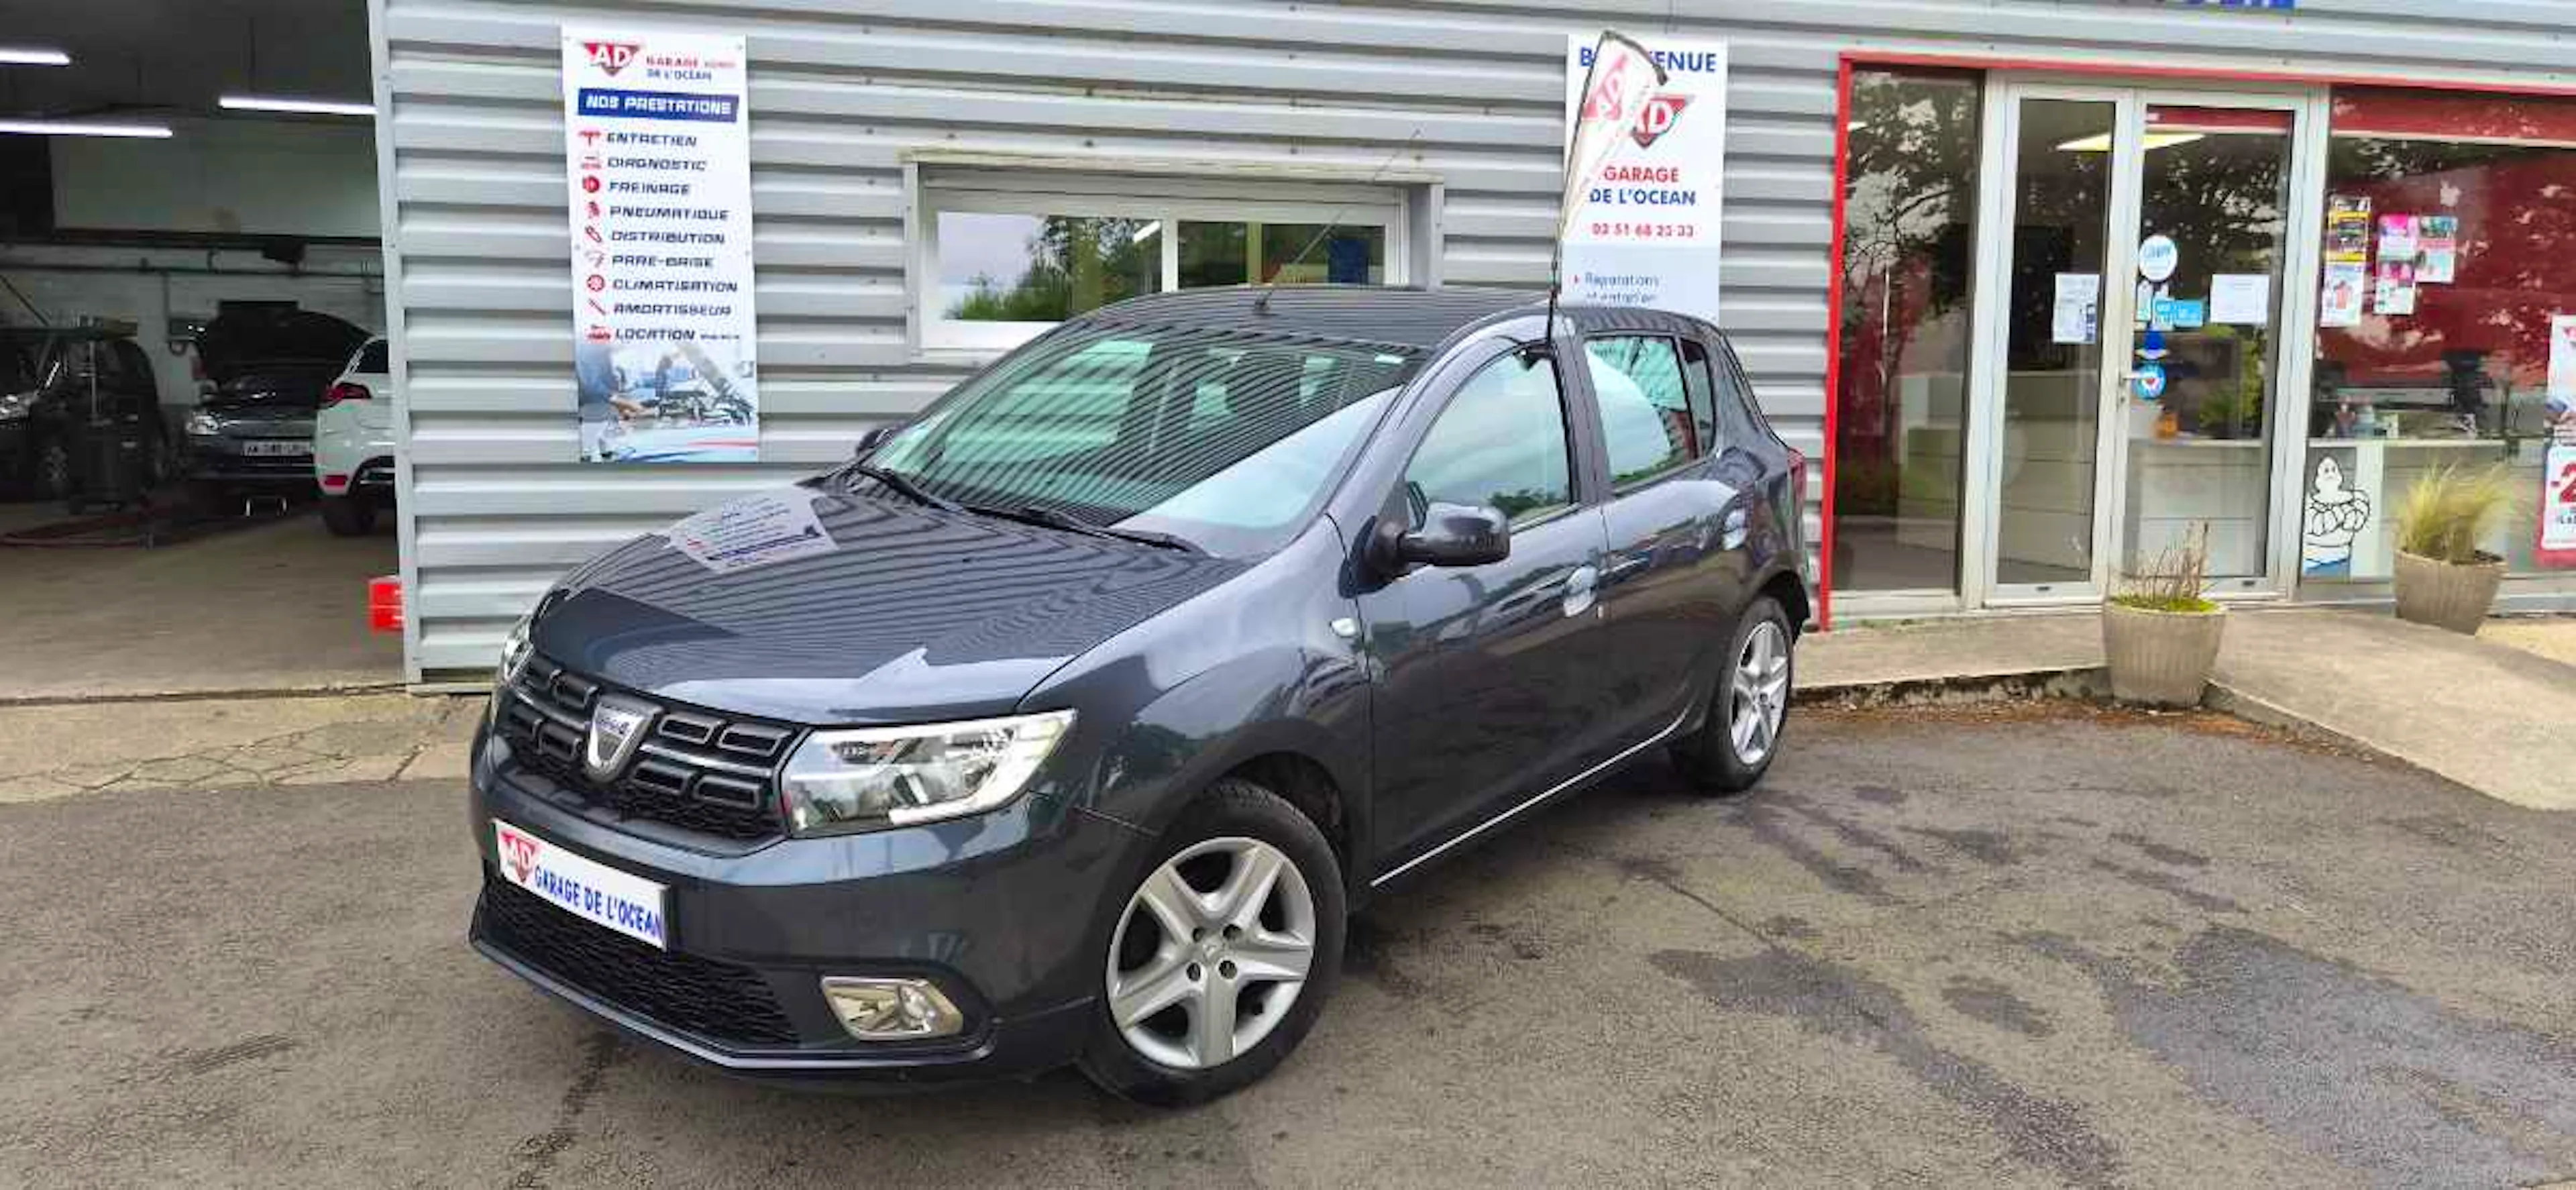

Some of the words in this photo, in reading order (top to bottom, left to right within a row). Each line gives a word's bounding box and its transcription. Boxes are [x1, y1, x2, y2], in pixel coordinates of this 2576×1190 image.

[589, 44, 633, 68] AD
[647, 56, 698, 68] GARAGE
[1580, 47, 1717, 73] BENUE
[586, 95, 620, 109] NOS
[625, 96, 732, 115] PRESTATIONS
[607, 132, 698, 147] ENTRETIEN
[607, 157, 706, 171] DIAGNOSTIC
[1604, 167, 1680, 183] GARAGE
[608, 181, 691, 195] FREINAGE
[1590, 188, 1611, 205] DE
[1619, 189, 1696, 205] L'OCEAN
[610, 206, 730, 221] PNEUMATIQUE
[610, 231, 725, 244] DISTRIBUTION
[612, 254, 714, 267] PARE-BRISE
[612, 278, 737, 292] CLIMATISATION
[614, 303, 732, 316] AMORTISSEUR
[616, 328, 696, 340] LOCATION
[535, 865, 580, 907] GARAGE
[584, 887, 602, 915] DE
[607, 894, 663, 939] L'OCEAN
